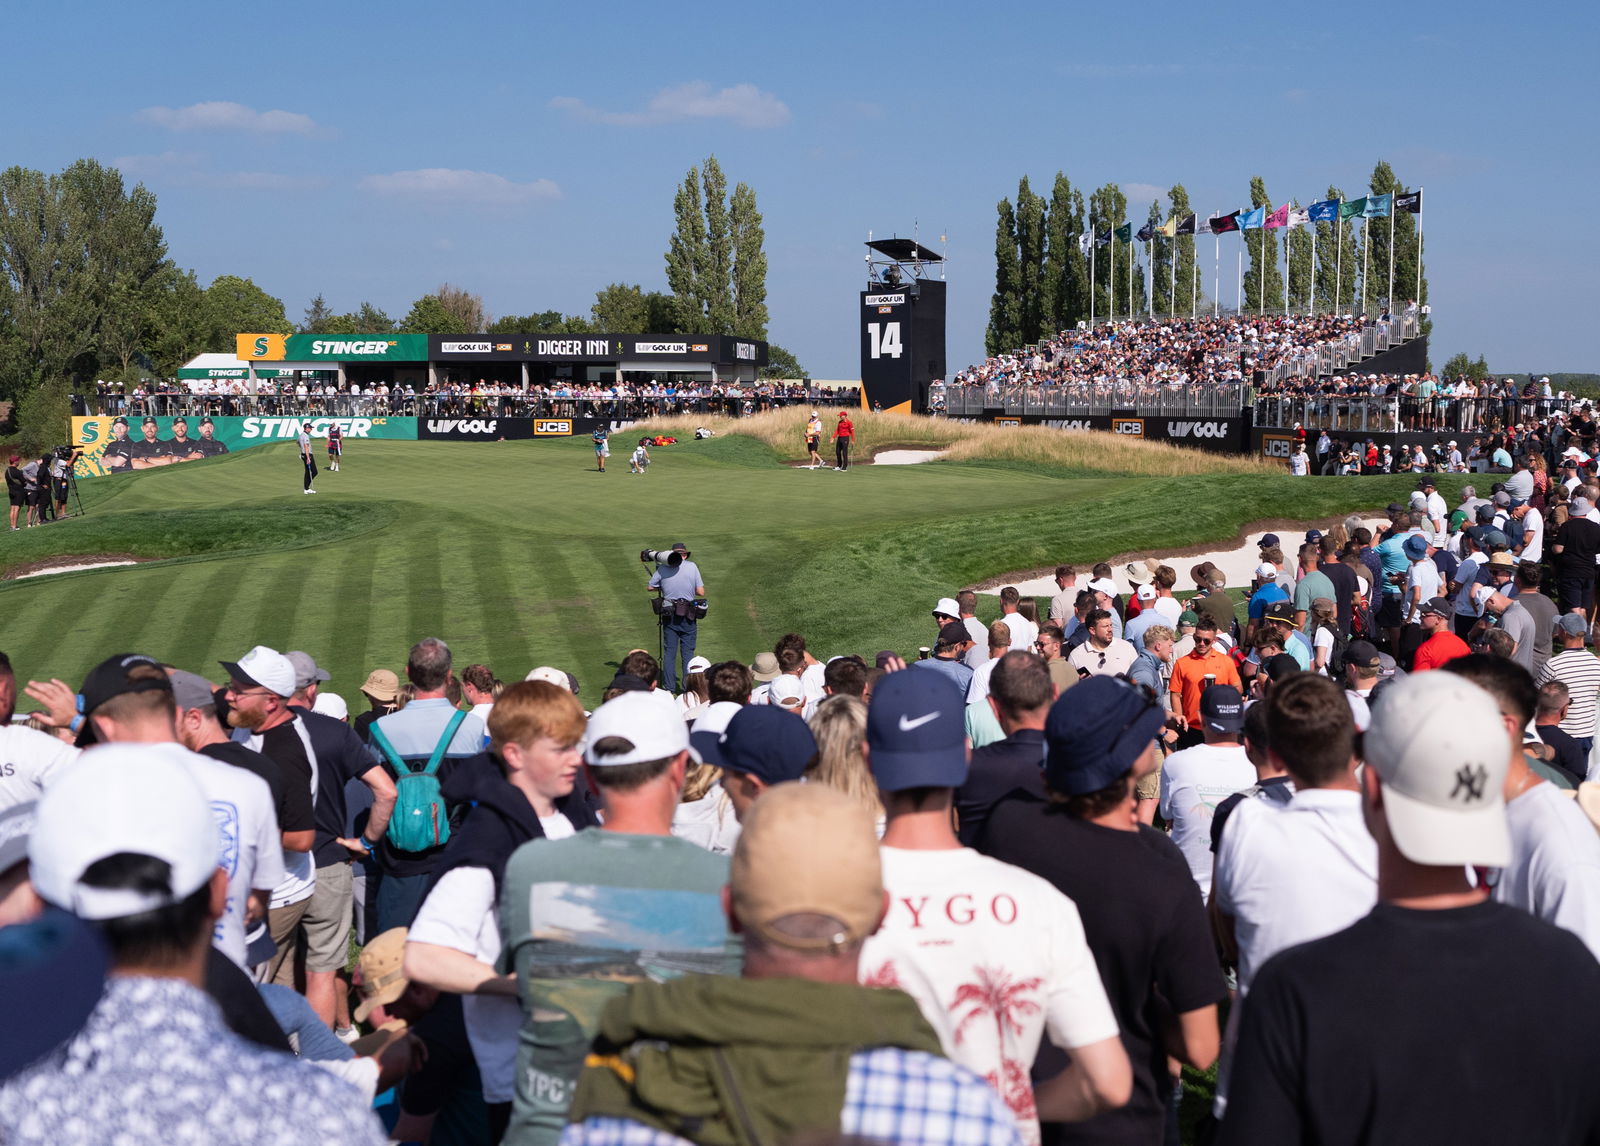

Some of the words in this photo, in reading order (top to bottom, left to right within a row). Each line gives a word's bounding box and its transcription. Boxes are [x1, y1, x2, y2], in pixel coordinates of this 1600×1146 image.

[252, 337, 269, 357] S
[312, 340, 389, 355] STINGER
[538, 340, 582, 355] DIGGER
[586, 340, 609, 355] INN
[673, 344, 685, 352] UK
[868, 322, 903, 359] 14
[208, 369, 244, 377] STINGER
[79, 421, 100, 444] S
[241, 417, 372, 438] STINGER
[371, 417, 387, 426] GC
[537, 422, 570, 433] JCB
[1114, 422, 1142, 434] JCB
[1264, 439, 1291, 458] JCB
[526, 1066, 565, 1103] TPC
